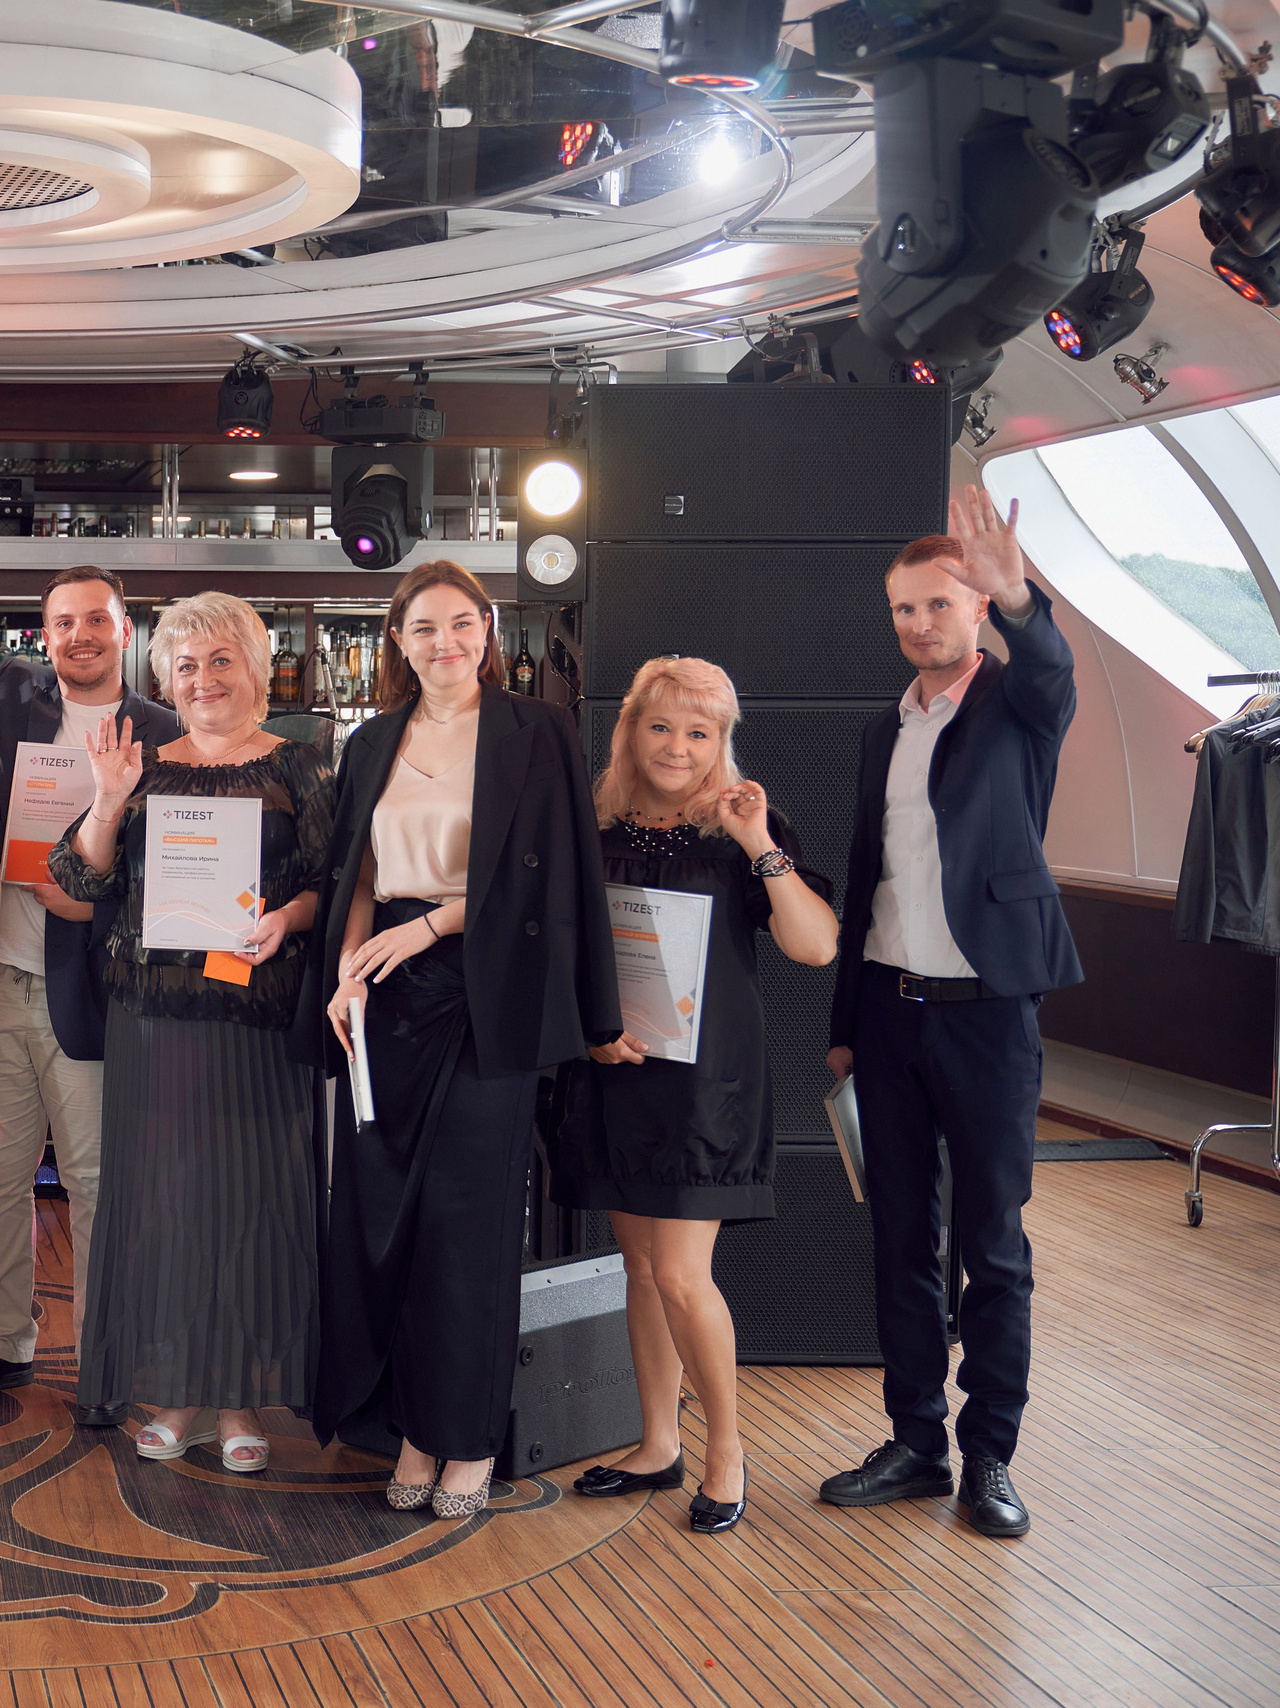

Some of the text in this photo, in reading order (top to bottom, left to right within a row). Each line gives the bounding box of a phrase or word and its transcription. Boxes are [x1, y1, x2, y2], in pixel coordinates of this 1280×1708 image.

[40, 757, 76, 768] TIZEST
[174, 810, 214, 821] TIZEST
[162, 854, 219, 863] Михайлова Ирина
[623, 901, 661, 915] TIZEST
